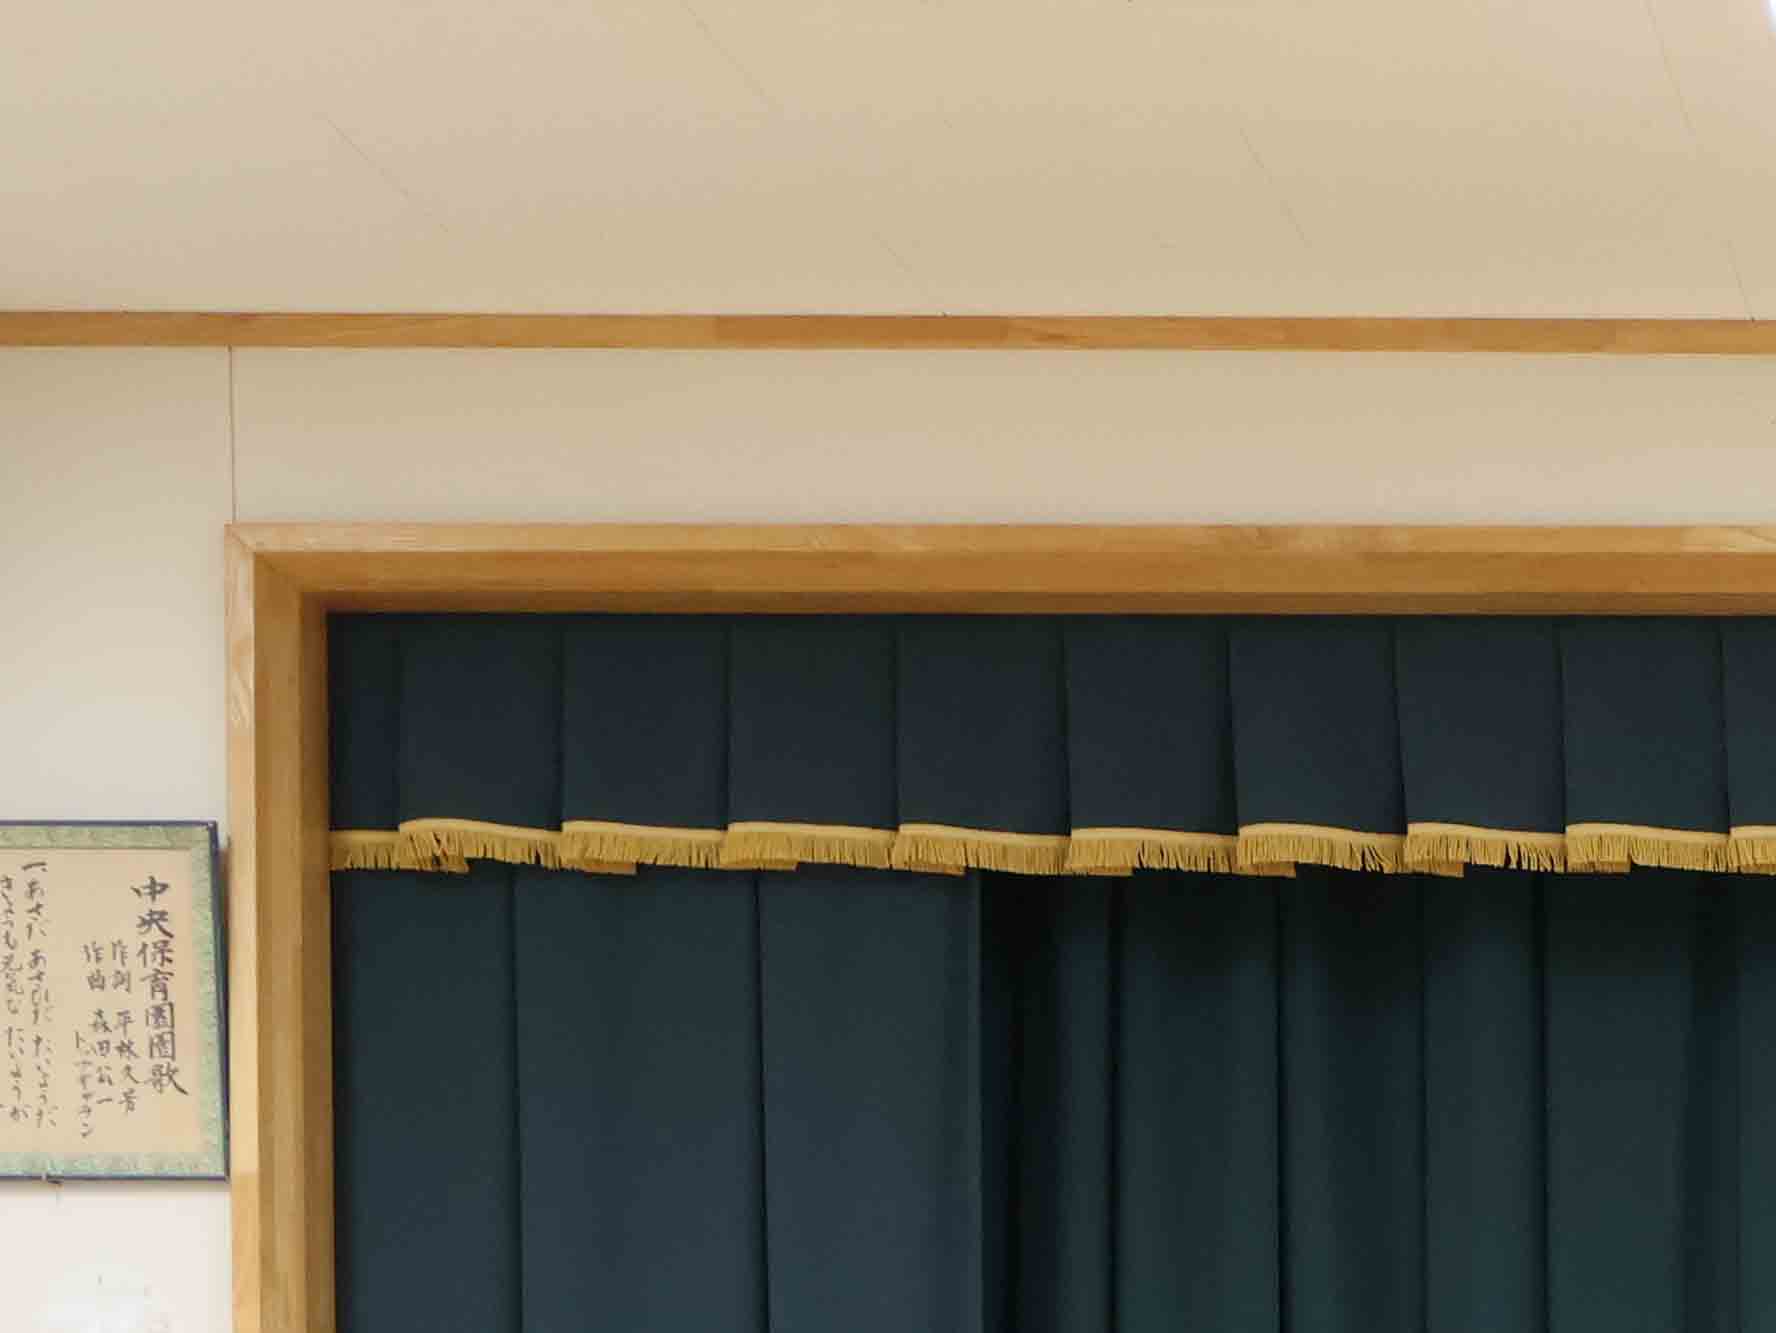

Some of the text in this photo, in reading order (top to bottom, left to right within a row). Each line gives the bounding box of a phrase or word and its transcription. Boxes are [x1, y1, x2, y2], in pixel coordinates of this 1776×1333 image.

[131, 876, 189, 1095] 中央保育園園歌
